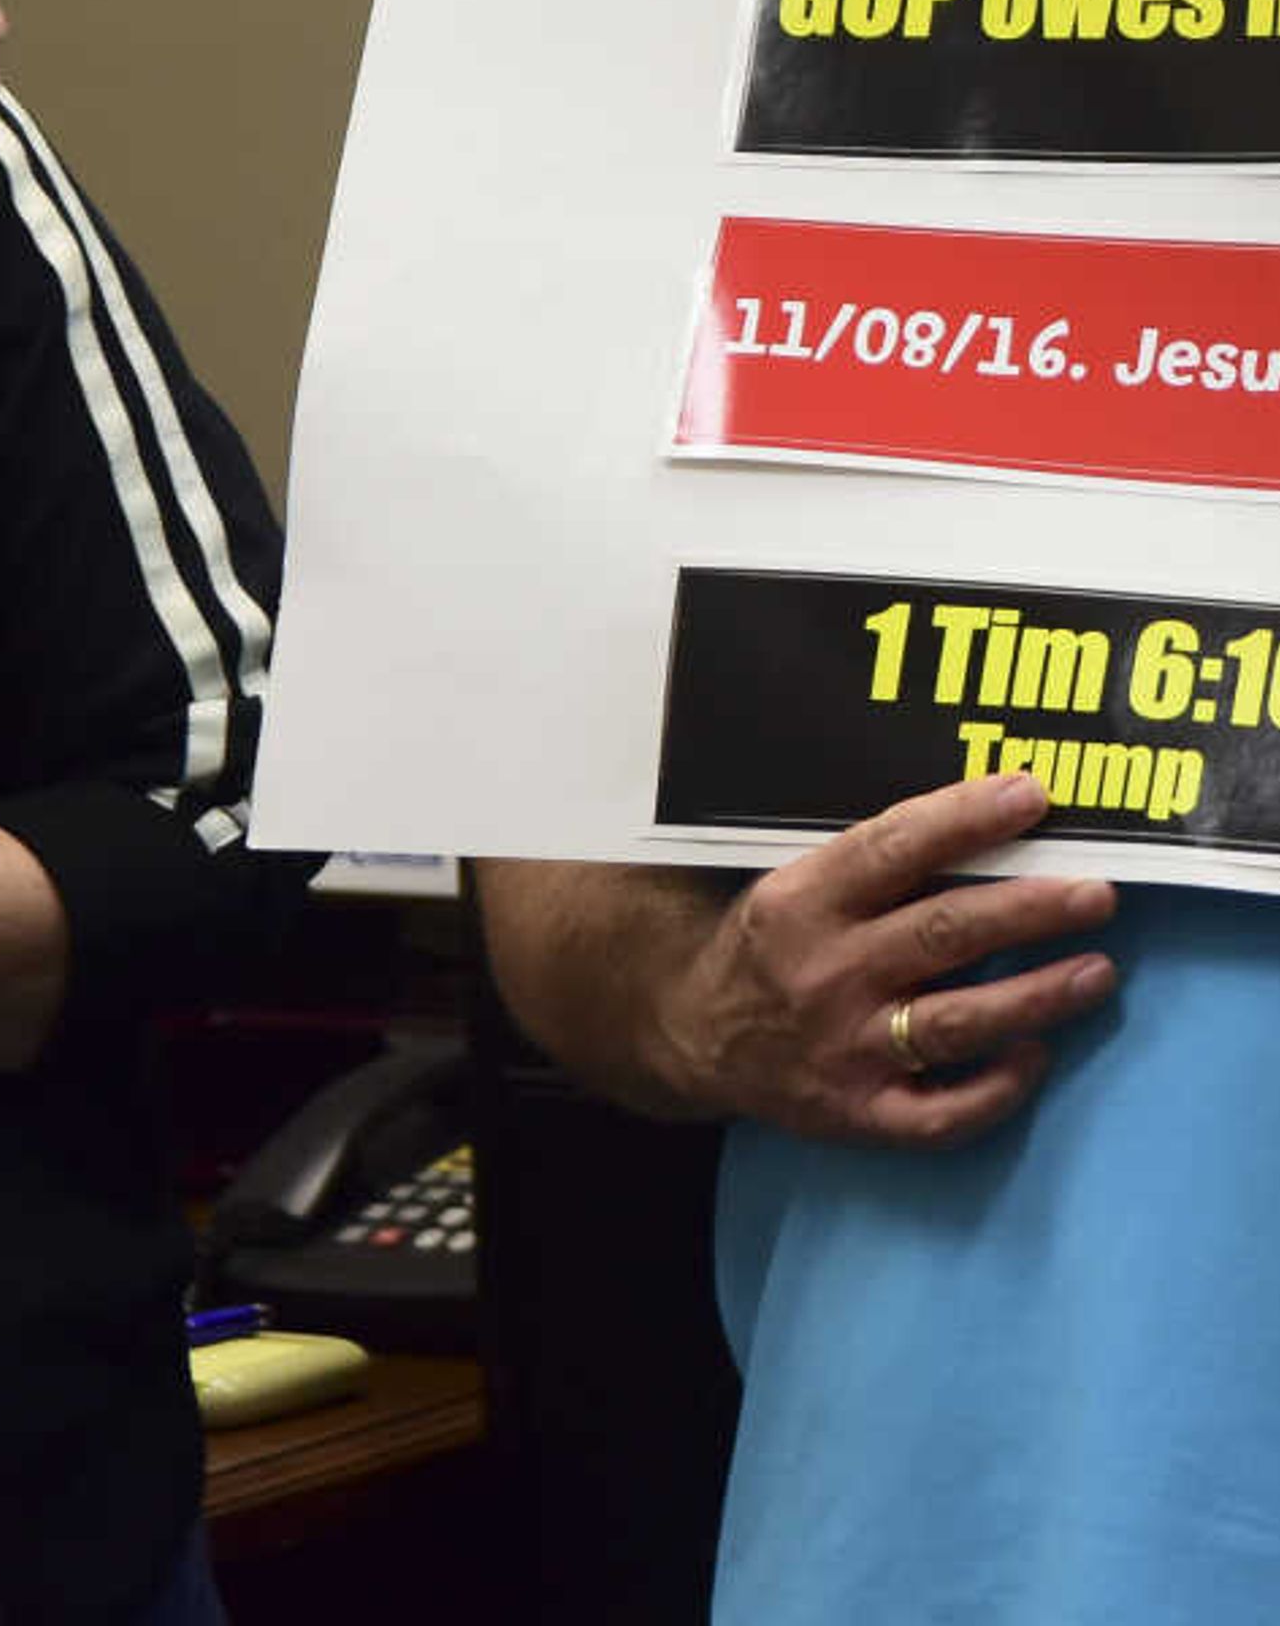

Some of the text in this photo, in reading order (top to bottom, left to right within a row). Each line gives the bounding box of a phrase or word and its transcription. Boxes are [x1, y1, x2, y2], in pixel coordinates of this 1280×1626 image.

[724, 297, 1087, 380] 11/08/16.
[865, 602, 911, 702] 1
[931, 604, 1110, 713] Tim
